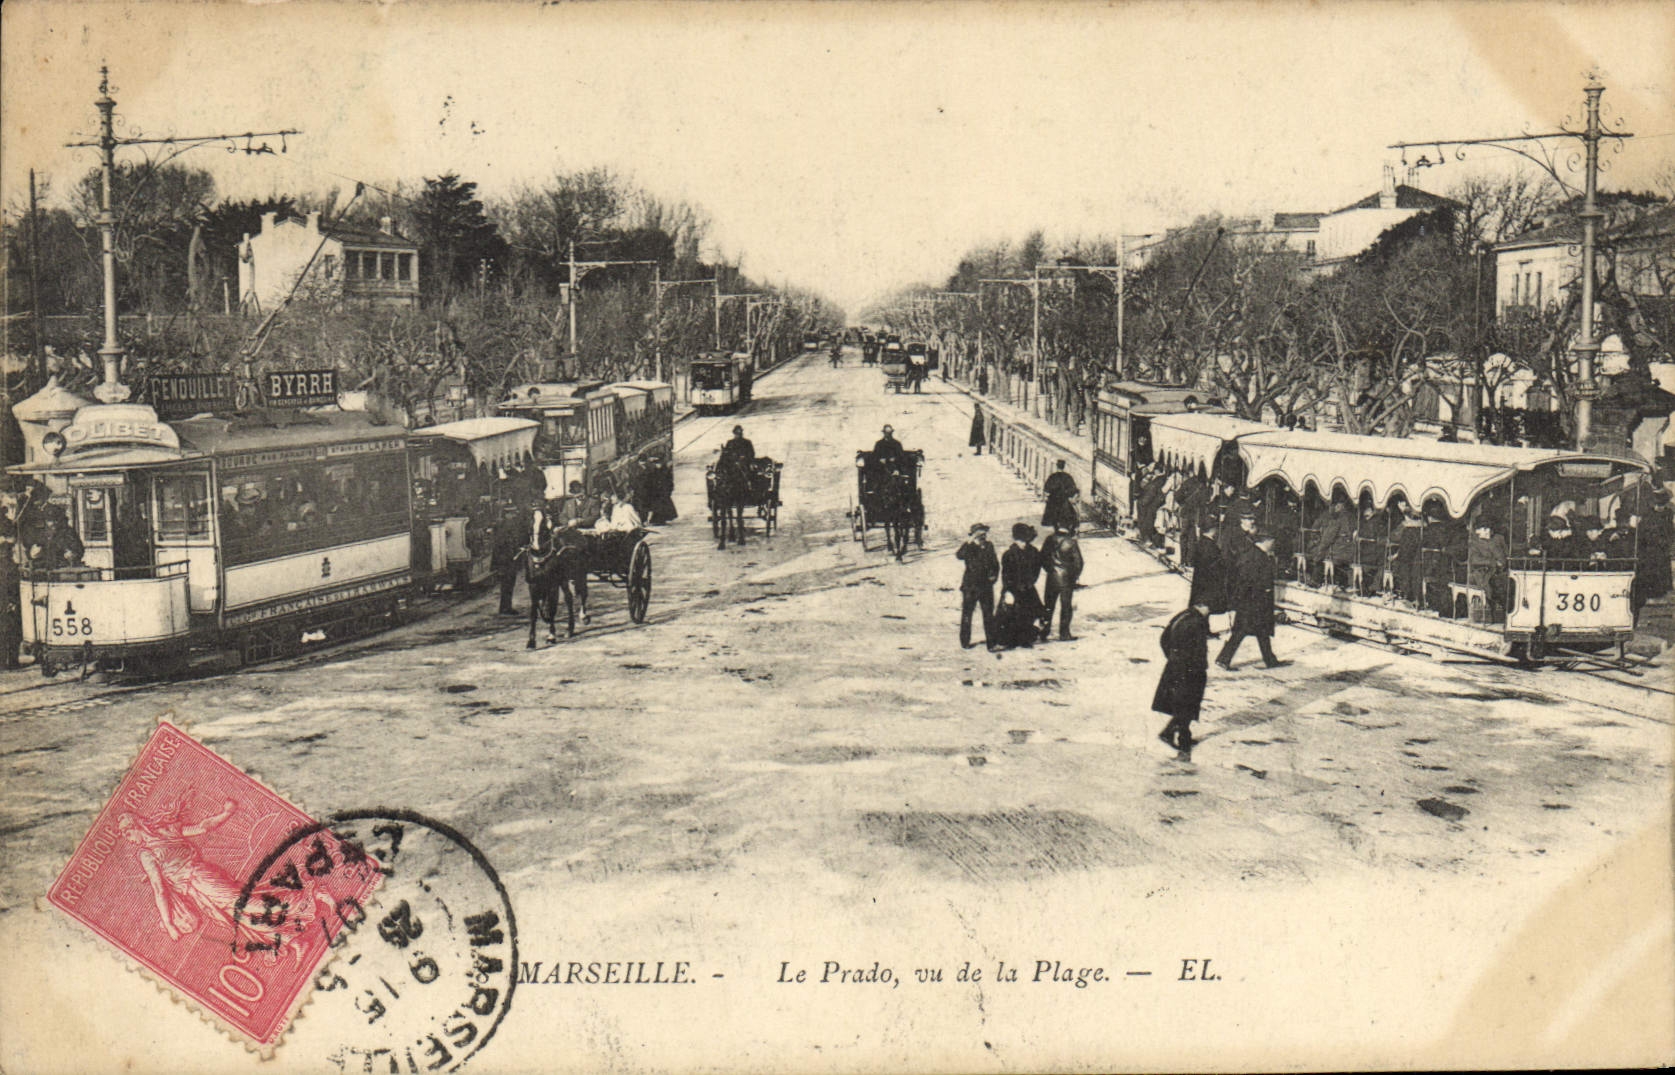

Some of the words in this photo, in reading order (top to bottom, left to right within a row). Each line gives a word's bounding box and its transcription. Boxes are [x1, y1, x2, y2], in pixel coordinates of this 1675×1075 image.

[270, 373, 334, 397] BYRRH
[68, 421, 165, 442] OLIBET
[1556, 593, 1601, 612] 380
[52, 617, 93, 636] 558
